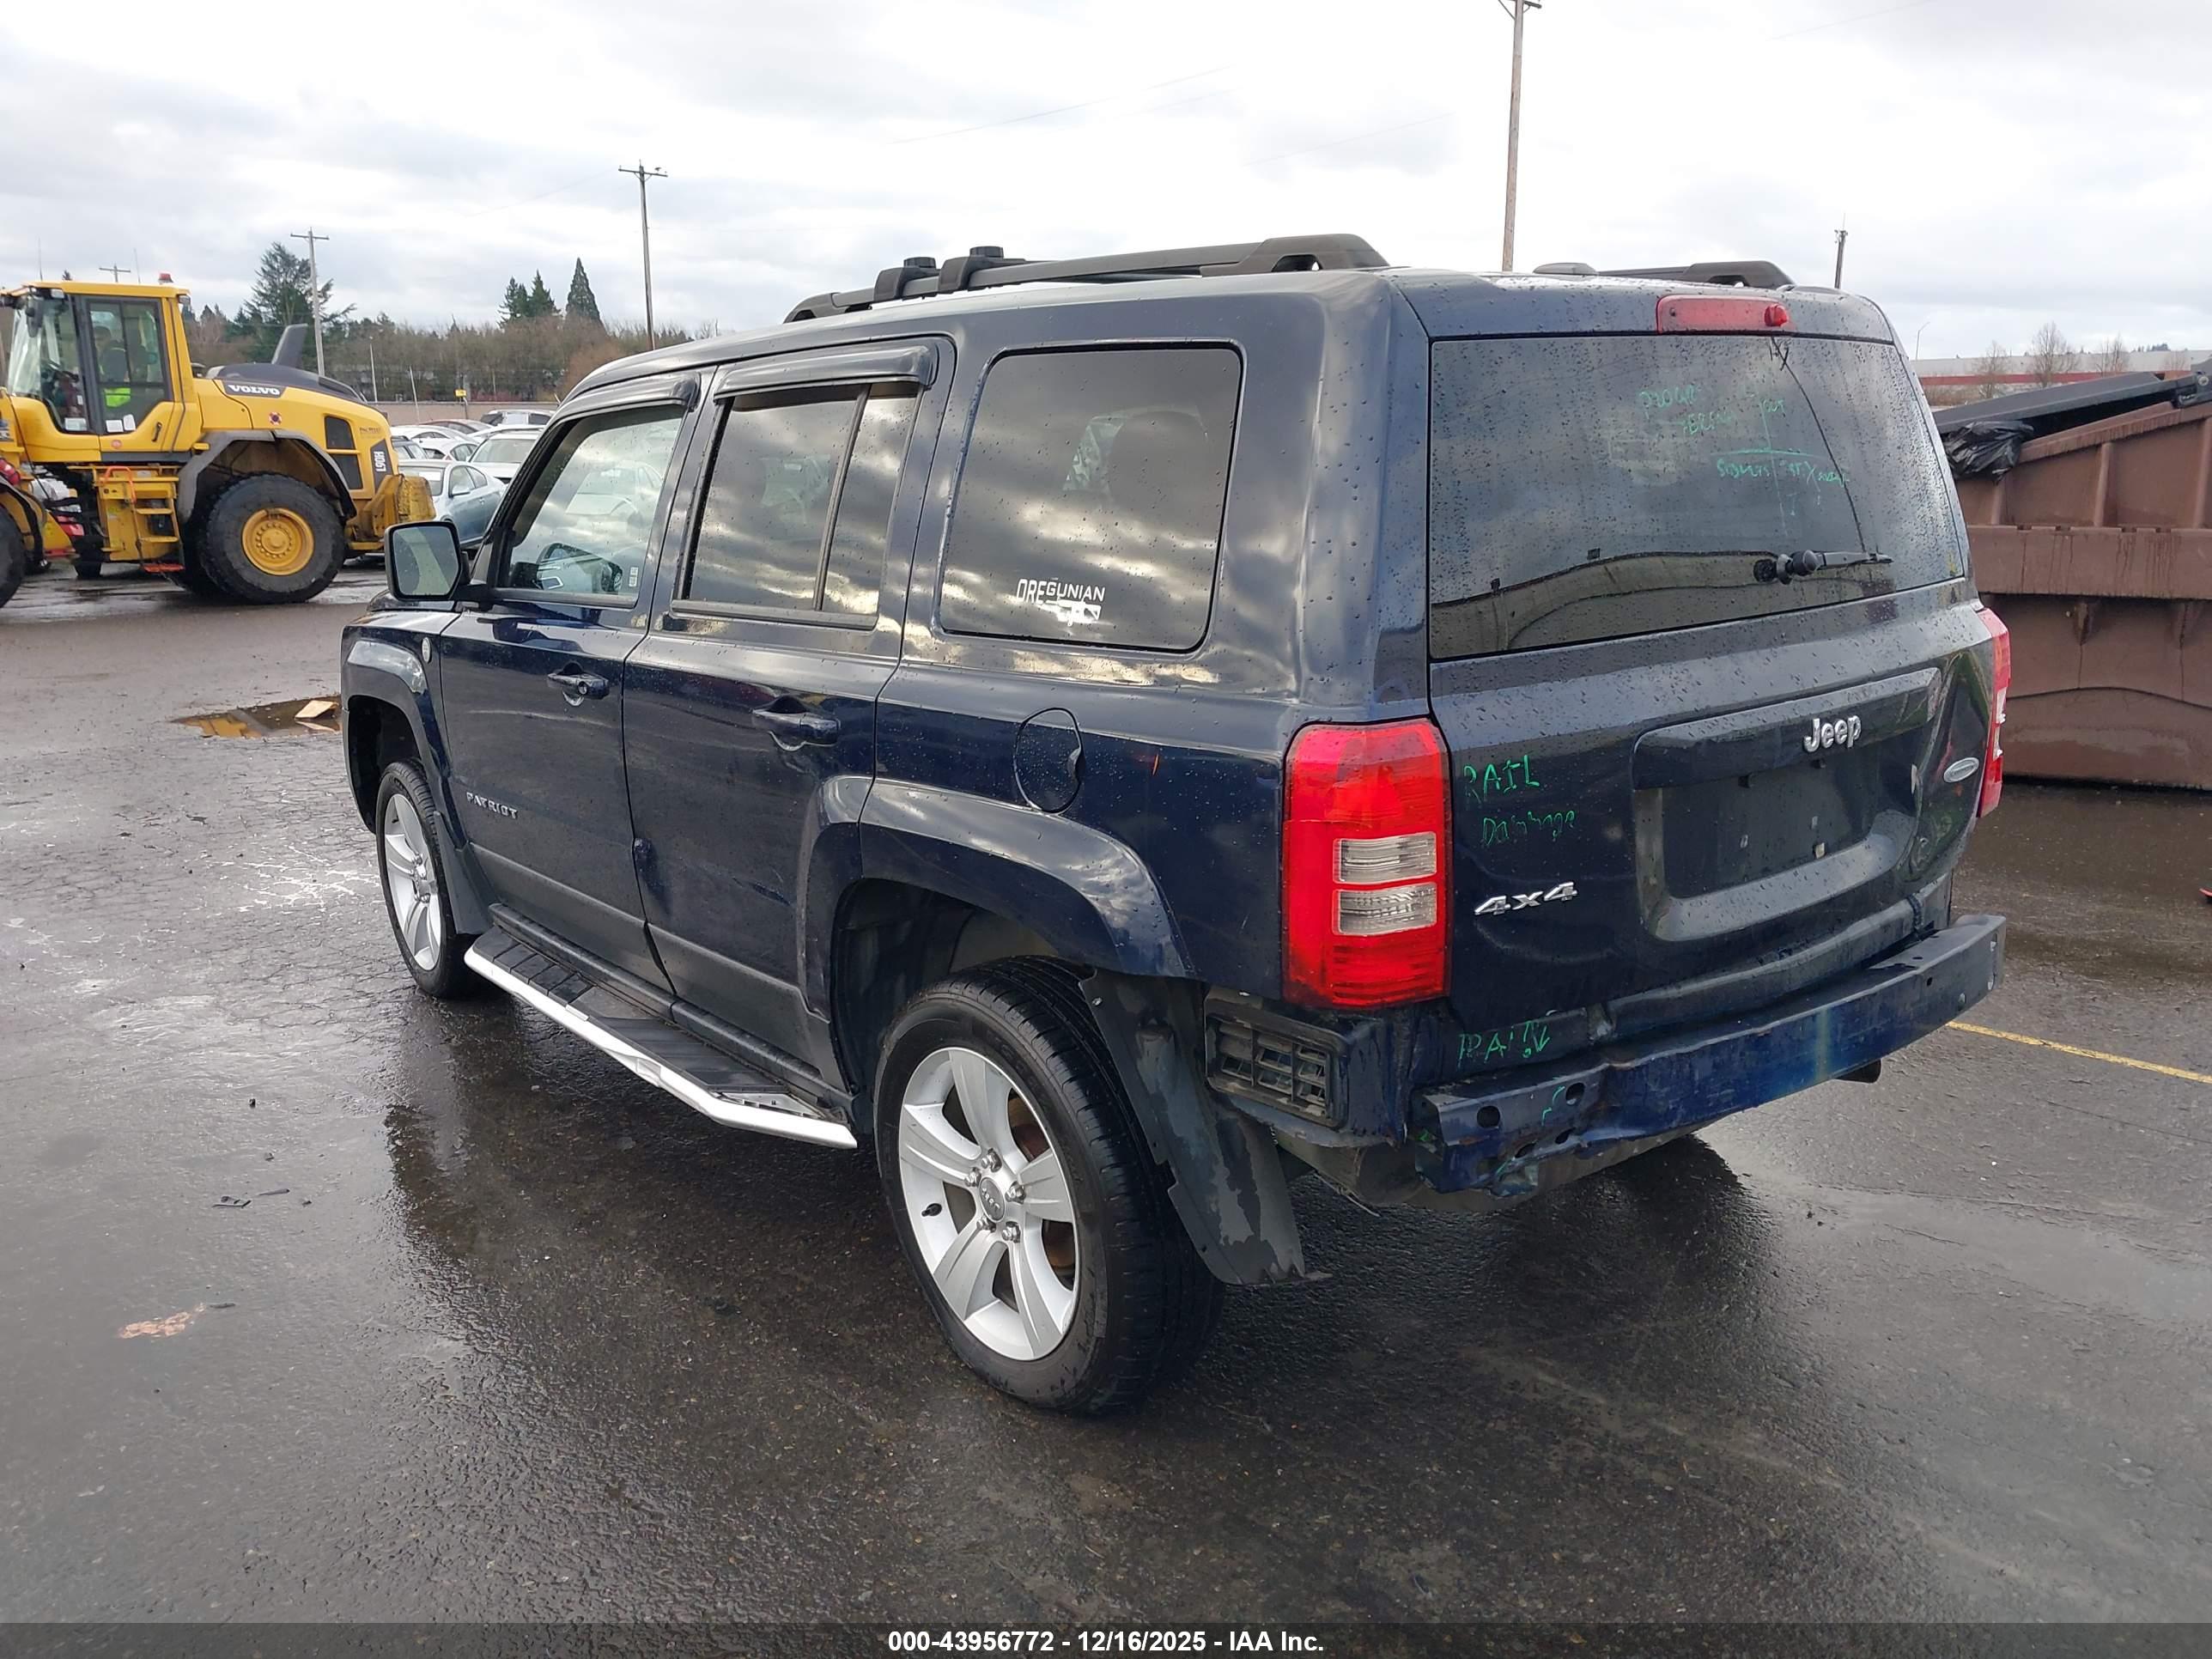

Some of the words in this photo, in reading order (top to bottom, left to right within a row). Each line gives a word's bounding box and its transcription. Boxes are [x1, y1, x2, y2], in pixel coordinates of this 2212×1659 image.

[228, 384, 281, 395] VOLVO
[1016, 578, 1106, 605] OREGUNIAN
[1804, 714, 1862, 753] Jeep
[466, 791, 518, 819] PATRIOT
